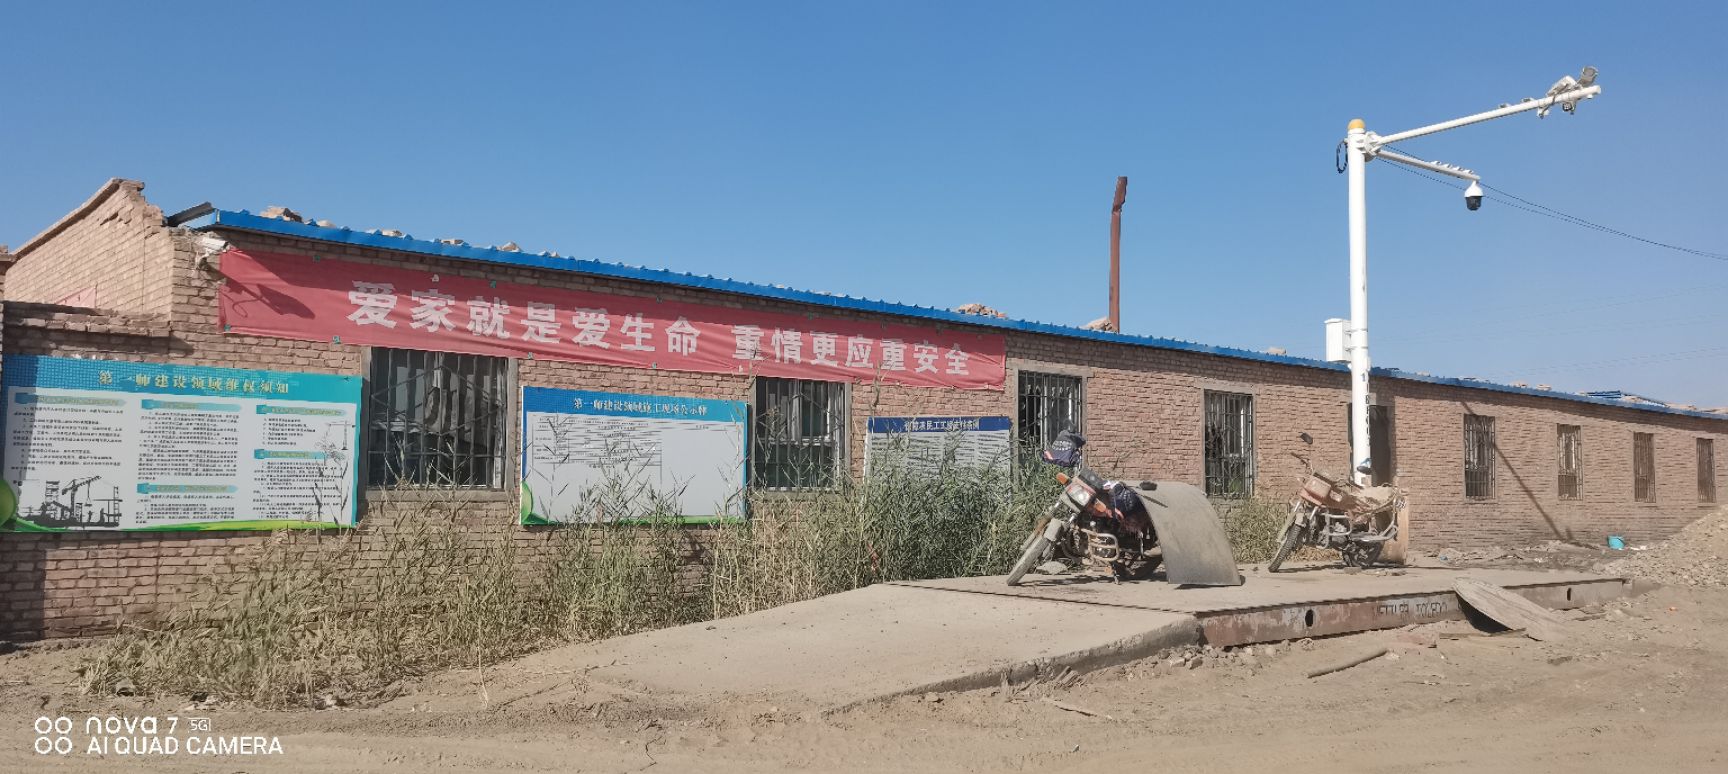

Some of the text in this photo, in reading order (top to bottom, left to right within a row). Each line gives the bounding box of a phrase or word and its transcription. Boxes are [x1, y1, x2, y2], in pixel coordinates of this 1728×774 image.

[346, 280, 970, 375] 爱家就是爱生命 重情更应重安全
[99, 369, 289, 394] 第一师建设领域维权须知
[574, 398, 707, 416] 第一师建设领域施工现场公示牌
